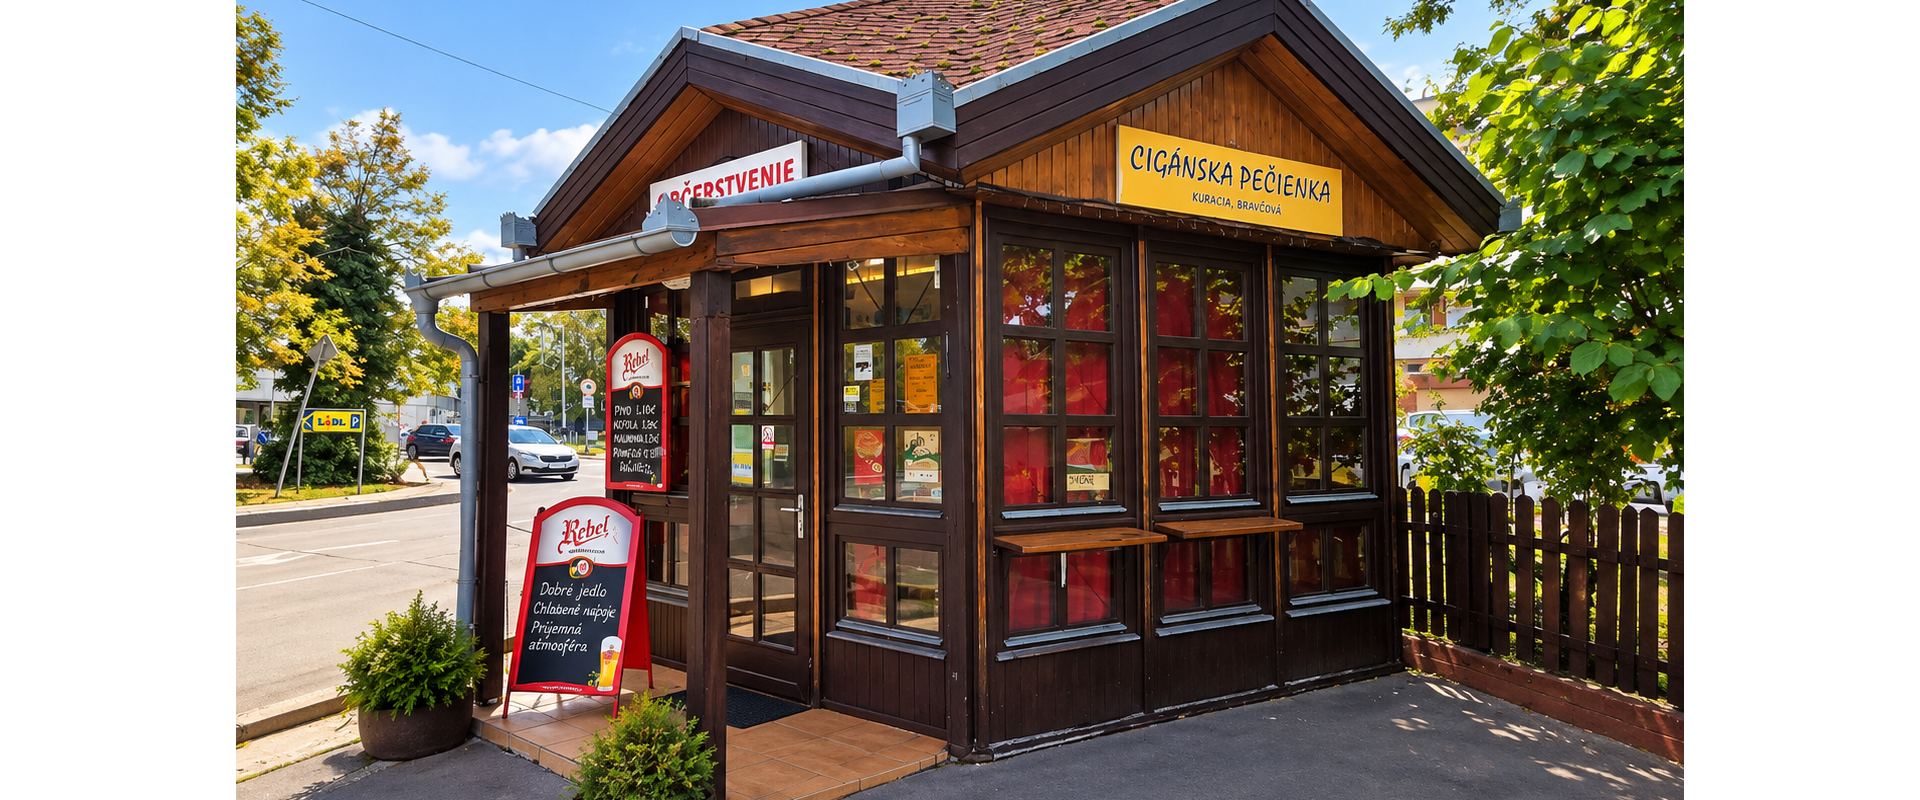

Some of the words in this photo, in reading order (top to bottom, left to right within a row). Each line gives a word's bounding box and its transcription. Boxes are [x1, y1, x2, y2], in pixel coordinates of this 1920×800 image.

[1130, 145, 1234, 187] CIGÁNSKA
[1239, 165, 1331, 203] PEČIENKA
[1192, 192, 1234, 210] KURACIA,
[557, 515, 610, 555] Rebel
[540, 581, 573, 597] Dobré
[575, 582, 608, 601] jedlo
